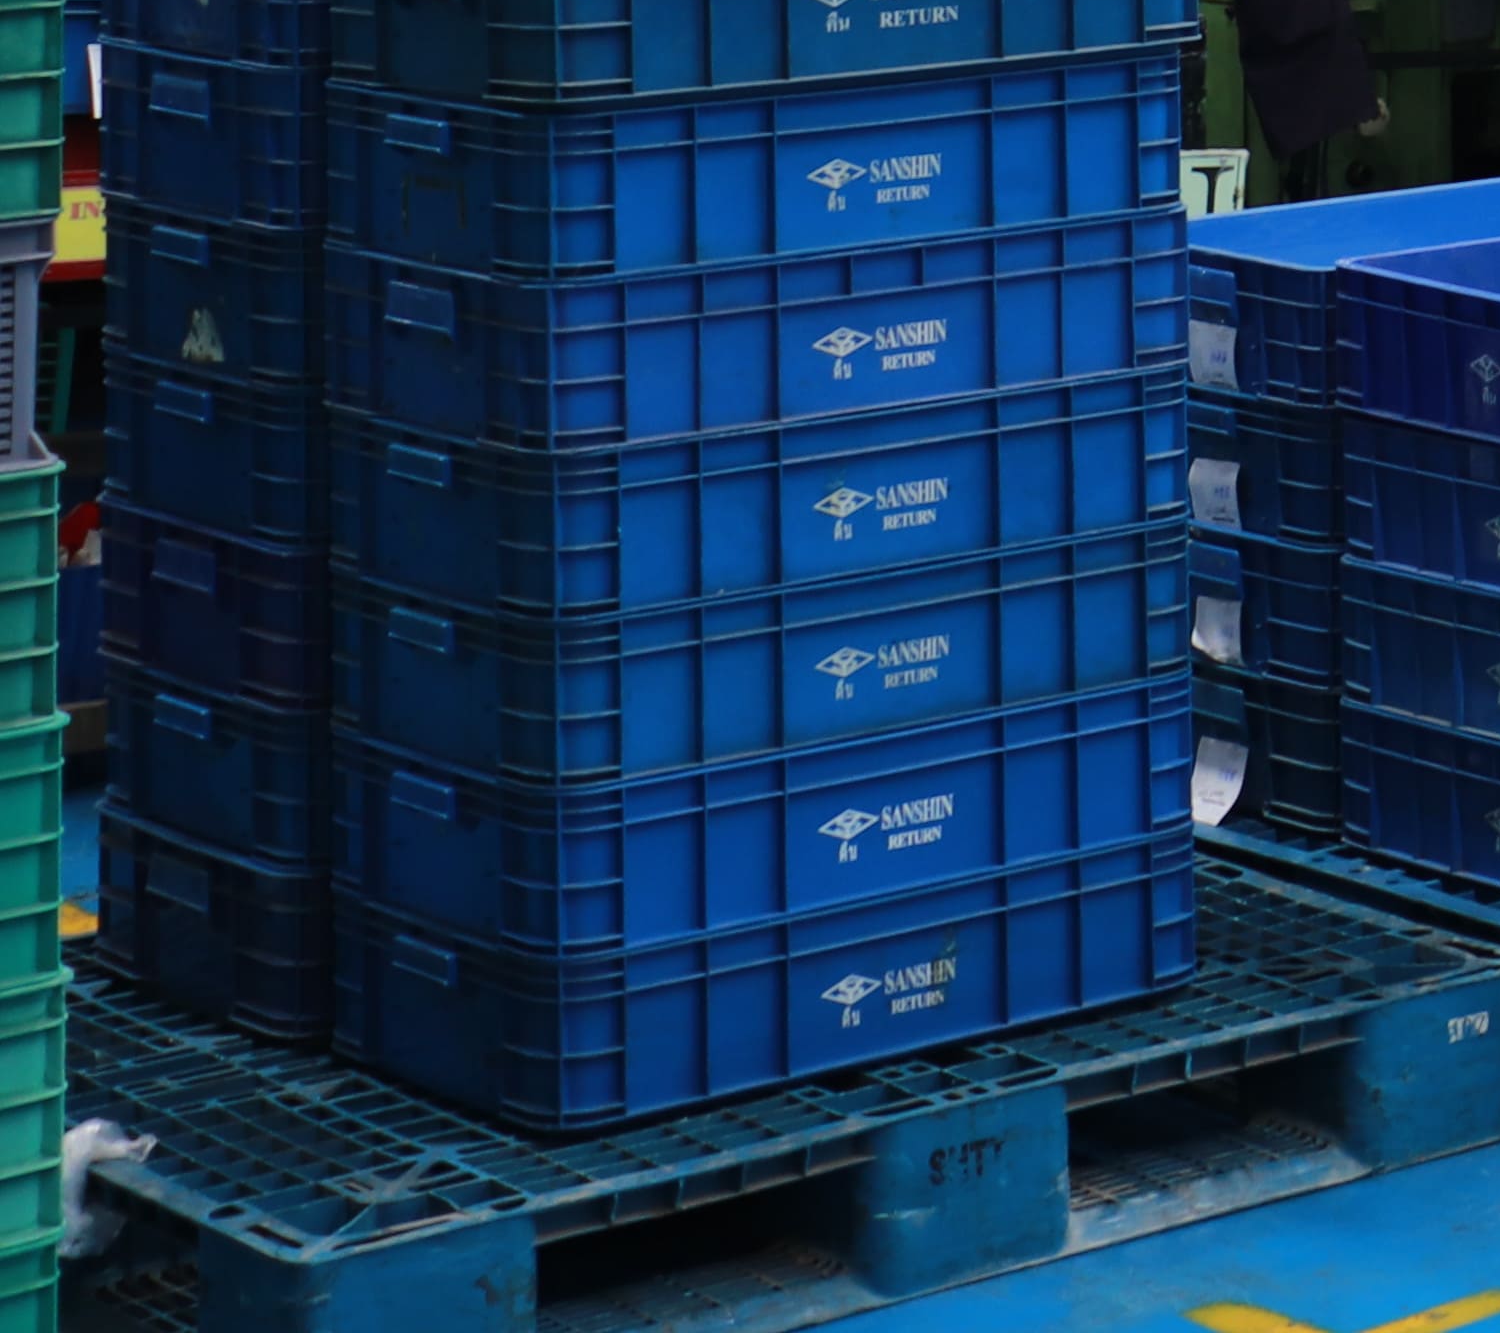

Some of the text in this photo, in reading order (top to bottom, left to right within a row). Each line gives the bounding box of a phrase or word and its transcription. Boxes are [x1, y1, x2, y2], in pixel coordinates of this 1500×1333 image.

[880, 5, 959, 29] RETURN
[870, 154, 941, 182] SANSHIN
[876, 184, 930, 204] RETURN
[874, 319, 946, 350] SANSHIN
[882, 350, 936, 371] RETURN
[876, 477, 948, 510] SANSHIN
[883, 508, 936, 531] RETURN
[877, 635, 950, 669] SANSHIN
[884, 665, 939, 689] RETURN
[881, 793, 954, 831] SANSHIN
[888, 826, 942, 851] RETURN
[884, 957, 956, 995] SANSHIN
[891, 990, 945, 1015] RETURN
